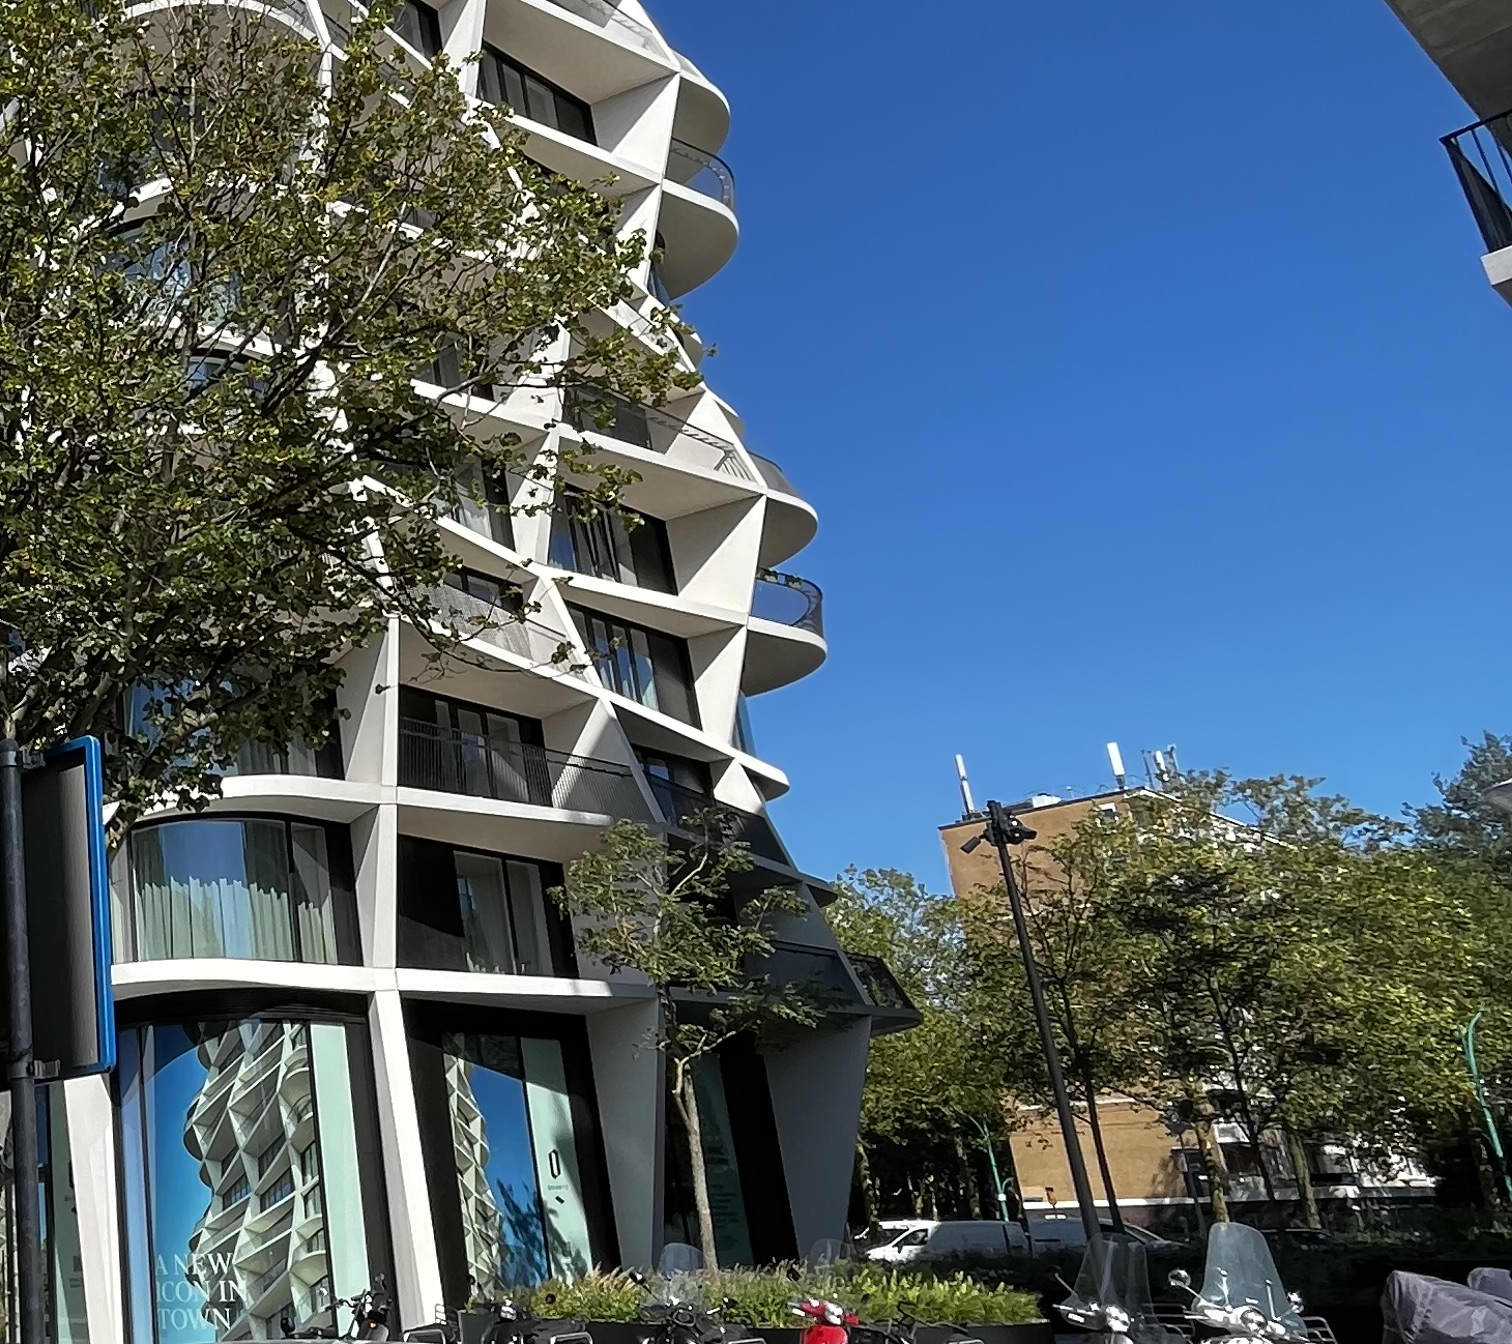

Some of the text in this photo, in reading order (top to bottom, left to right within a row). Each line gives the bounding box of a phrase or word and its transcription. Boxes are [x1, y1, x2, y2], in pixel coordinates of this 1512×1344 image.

[157, 1253, 233, 1276] A NEW
[158, 1280, 248, 1303] ICON IN
[158, 1308, 231, 1331] TOWN
